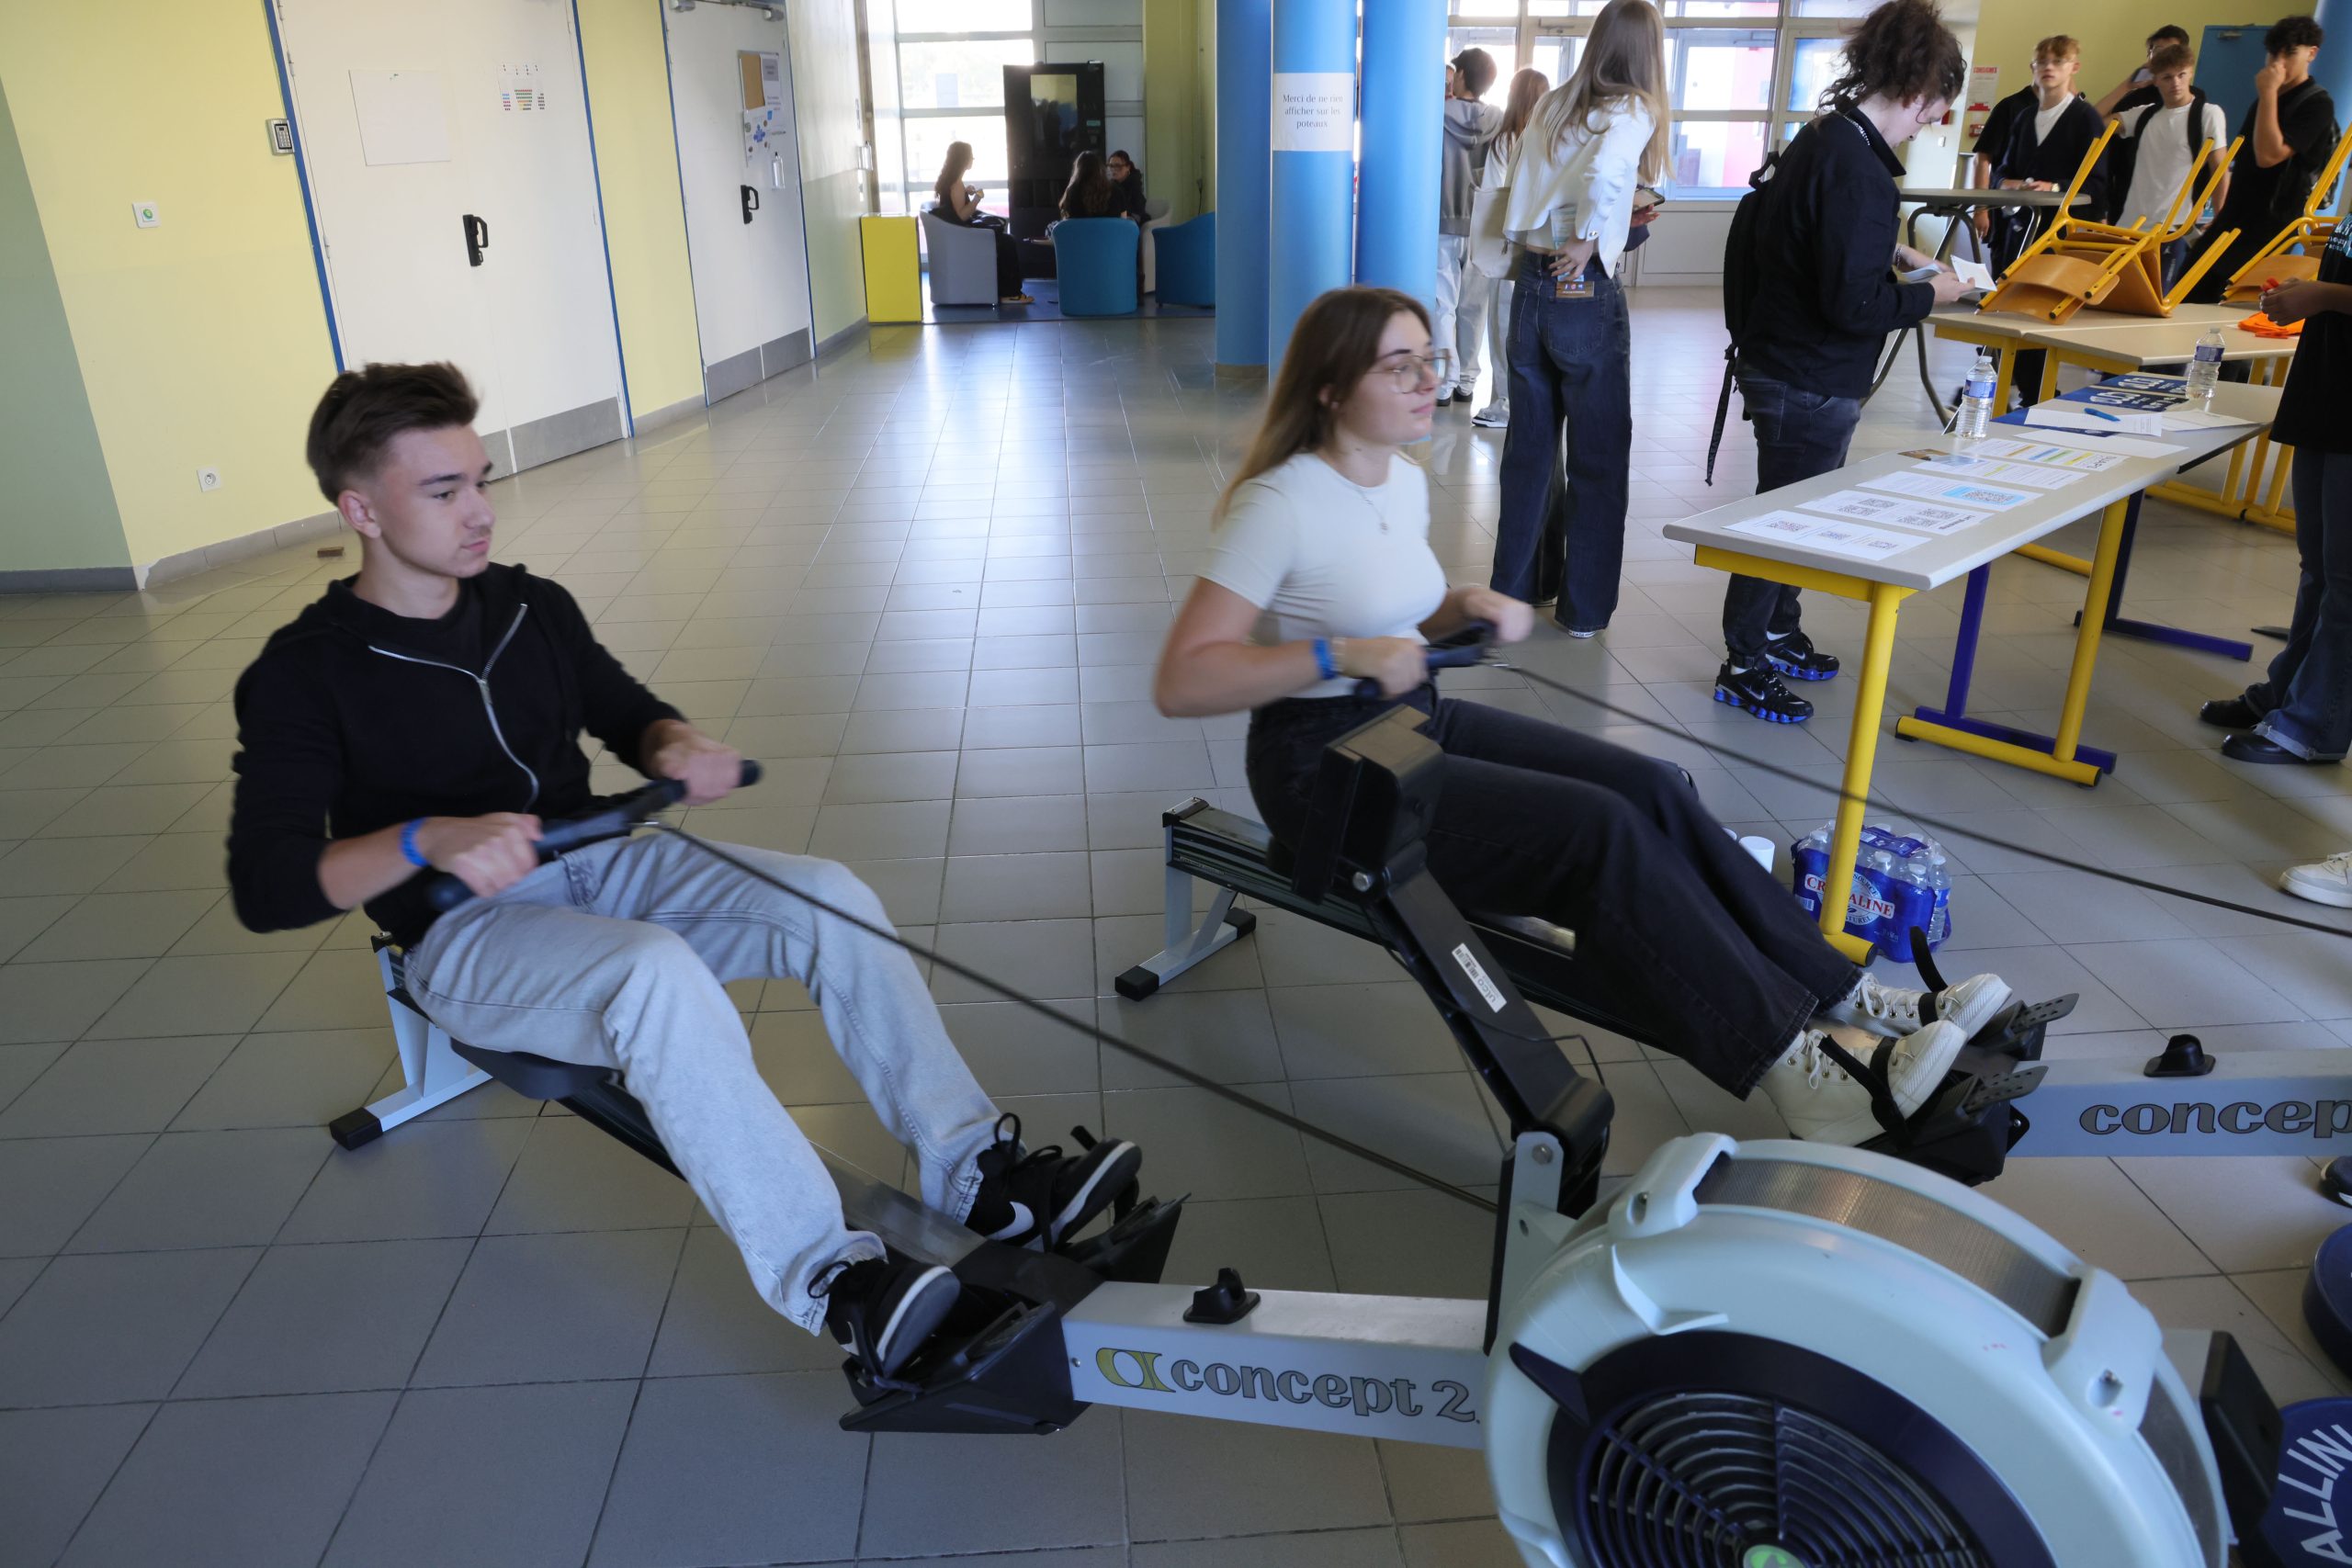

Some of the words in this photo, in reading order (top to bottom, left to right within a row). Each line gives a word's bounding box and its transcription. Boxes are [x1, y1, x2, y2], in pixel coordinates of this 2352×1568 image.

[1283, 94, 1304, 103] Merci
[1306, 94, 1317, 103] de
[1329, 95, 1343, 103] rien
[1284, 106, 1315, 116] afficher
[1316, 107, 1329, 116] sur
[1330, 106, 1341, 116] les
[1296, 119, 1329, 130] poteaux
[1807, 876, 1893, 917] CRALINE
[1170, 1359, 1423, 1416] concept
